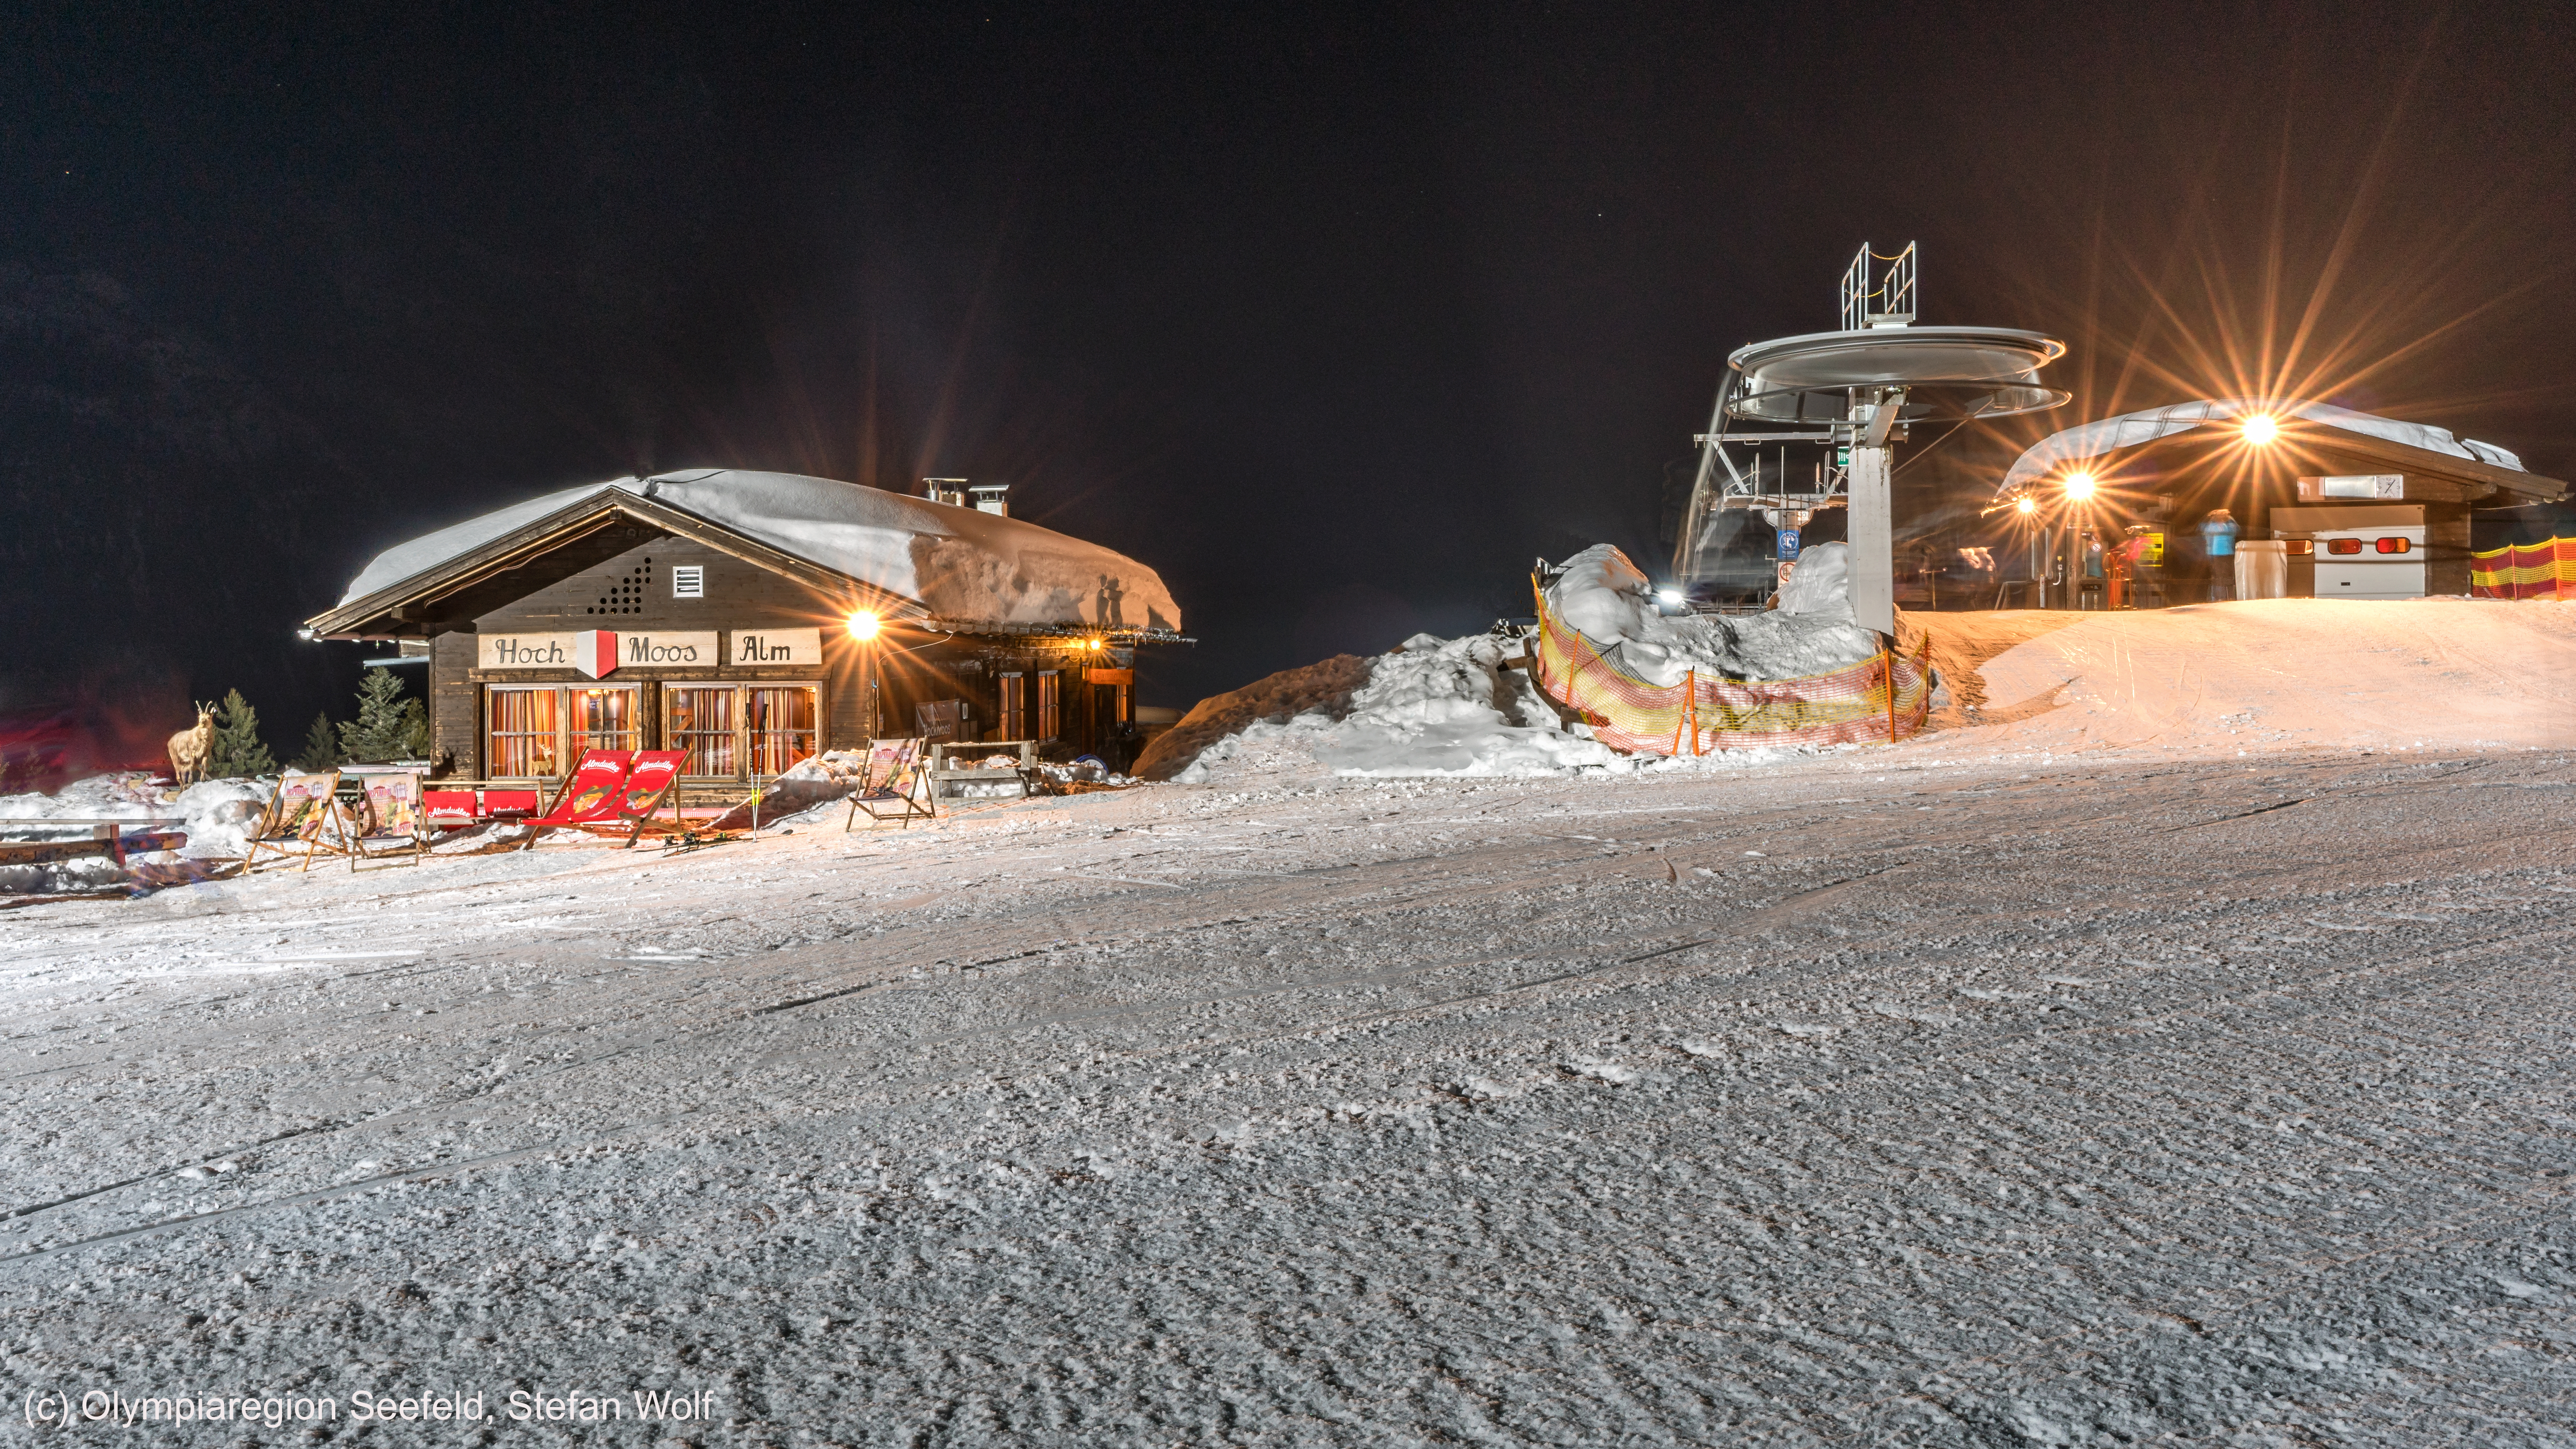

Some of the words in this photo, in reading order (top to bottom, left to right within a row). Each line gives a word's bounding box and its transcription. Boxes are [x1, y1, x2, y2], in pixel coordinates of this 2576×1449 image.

[495, 639, 565, 663] Hoch
[629, 637, 698, 662] Moos
[739, 636, 790, 661] Alm
[581, 759, 620, 773] Almdudler
[635, 760, 674, 773] Almdudler
[428, 806, 470, 818] Almdudler
[488, 806, 530, 818] Almdudler
